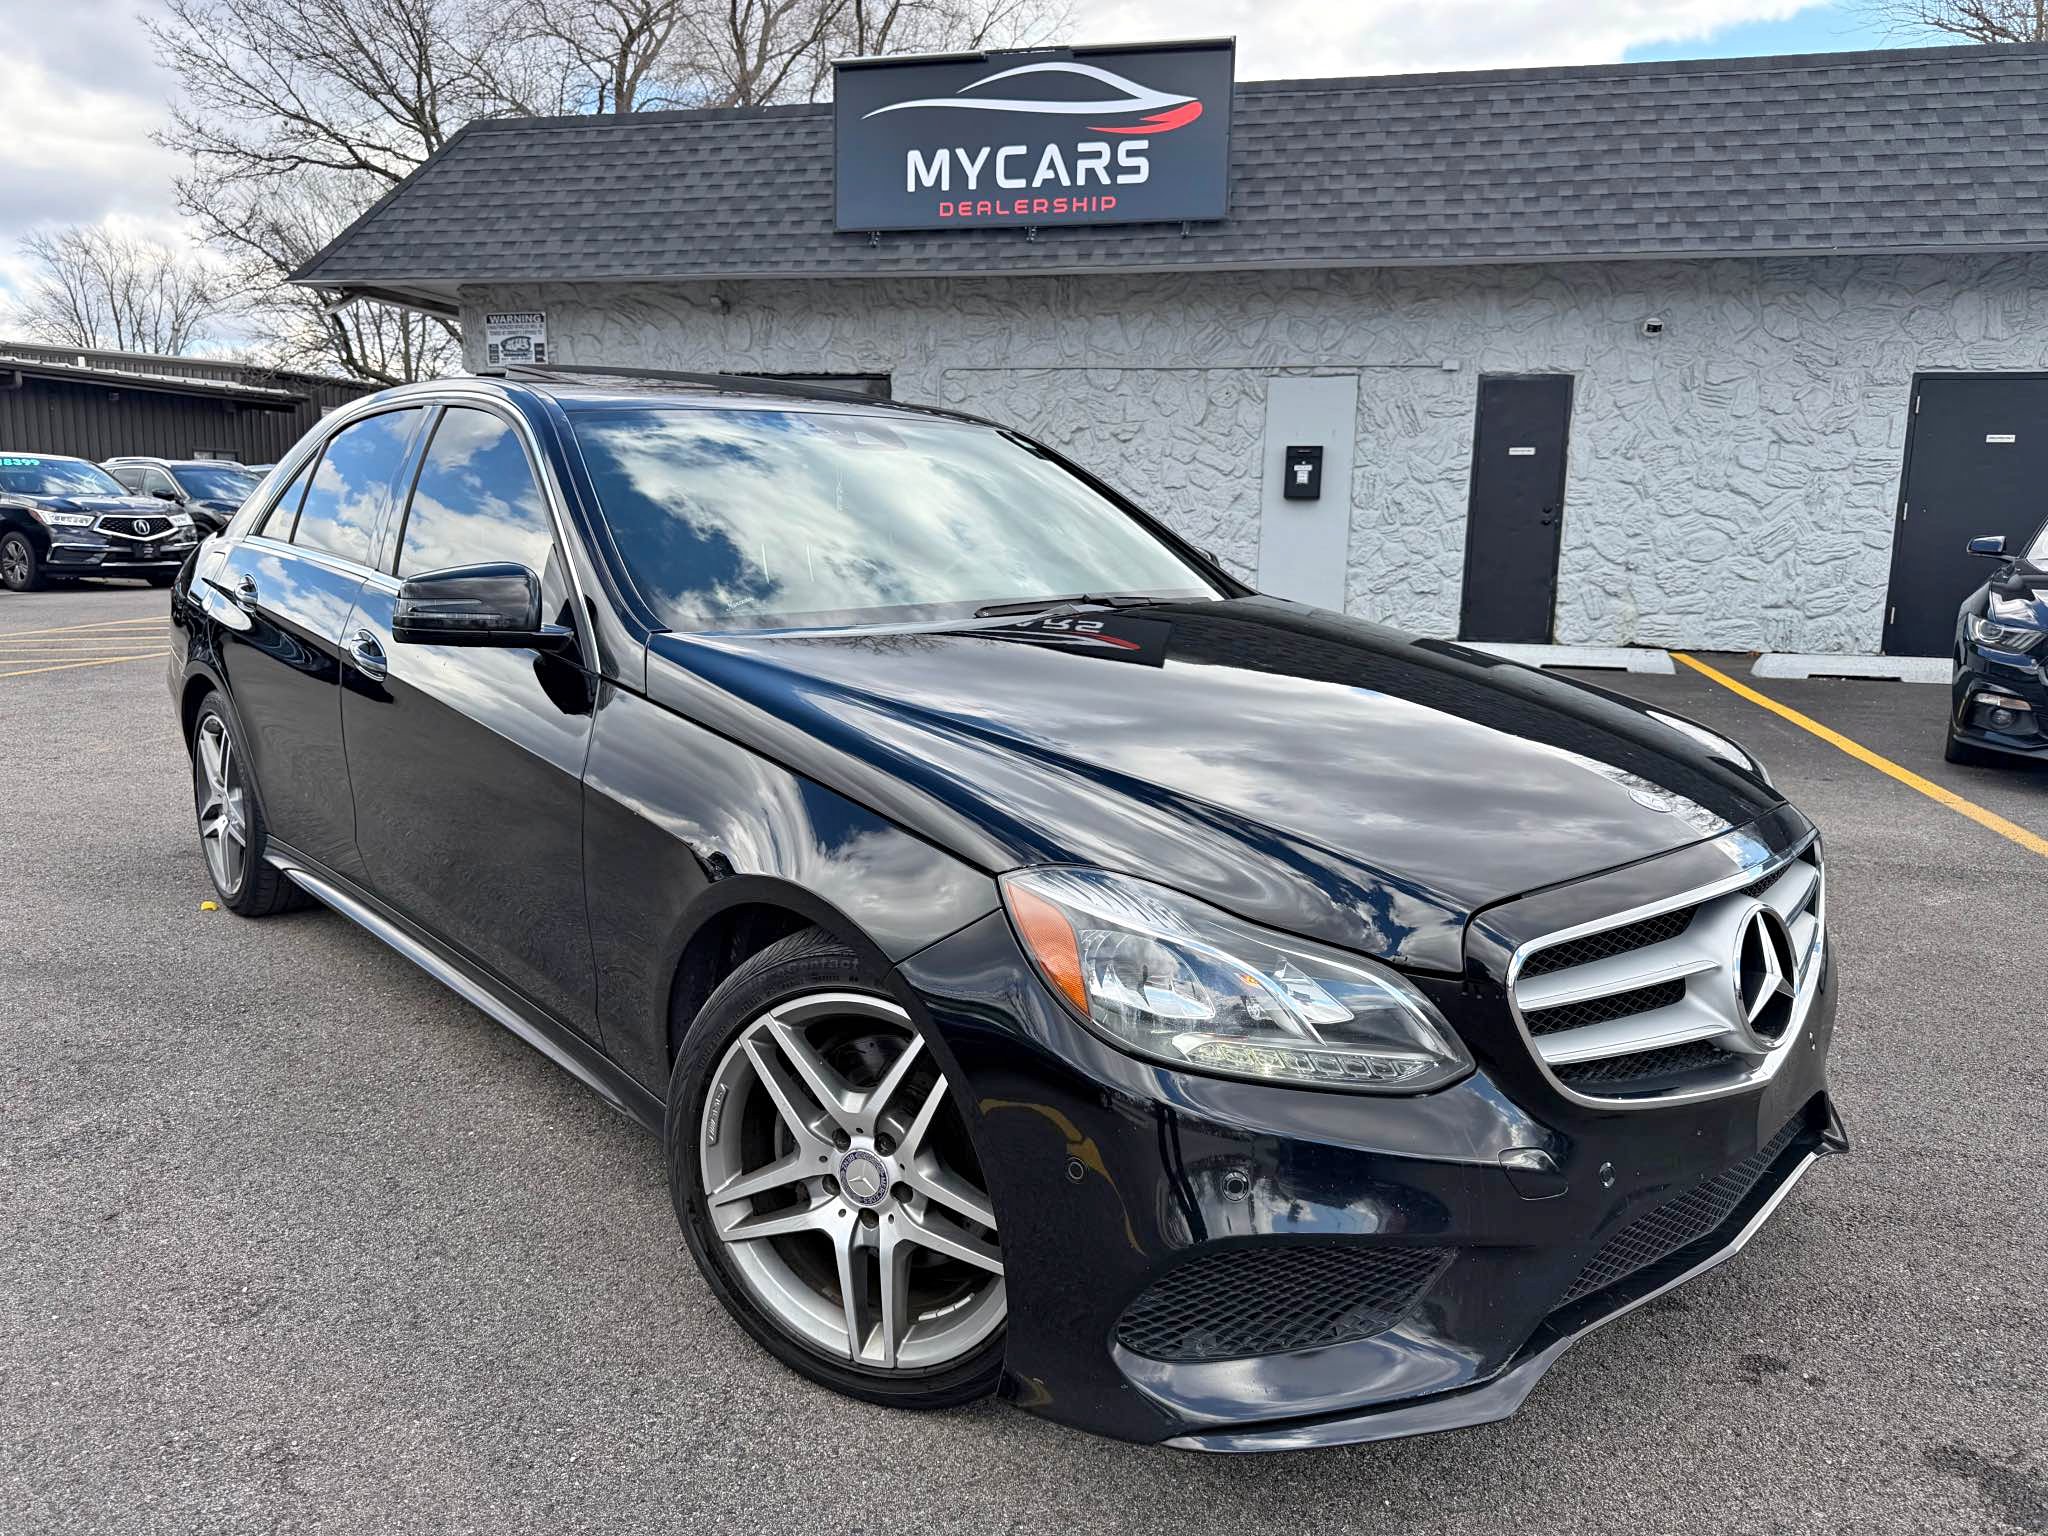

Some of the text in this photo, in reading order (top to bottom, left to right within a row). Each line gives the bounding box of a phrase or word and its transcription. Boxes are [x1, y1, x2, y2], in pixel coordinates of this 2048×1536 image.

[906, 139, 1150, 193] MYCARS
[939, 196, 1118, 217] DEALERSHIP
[489, 314, 541, 324] WARNING
